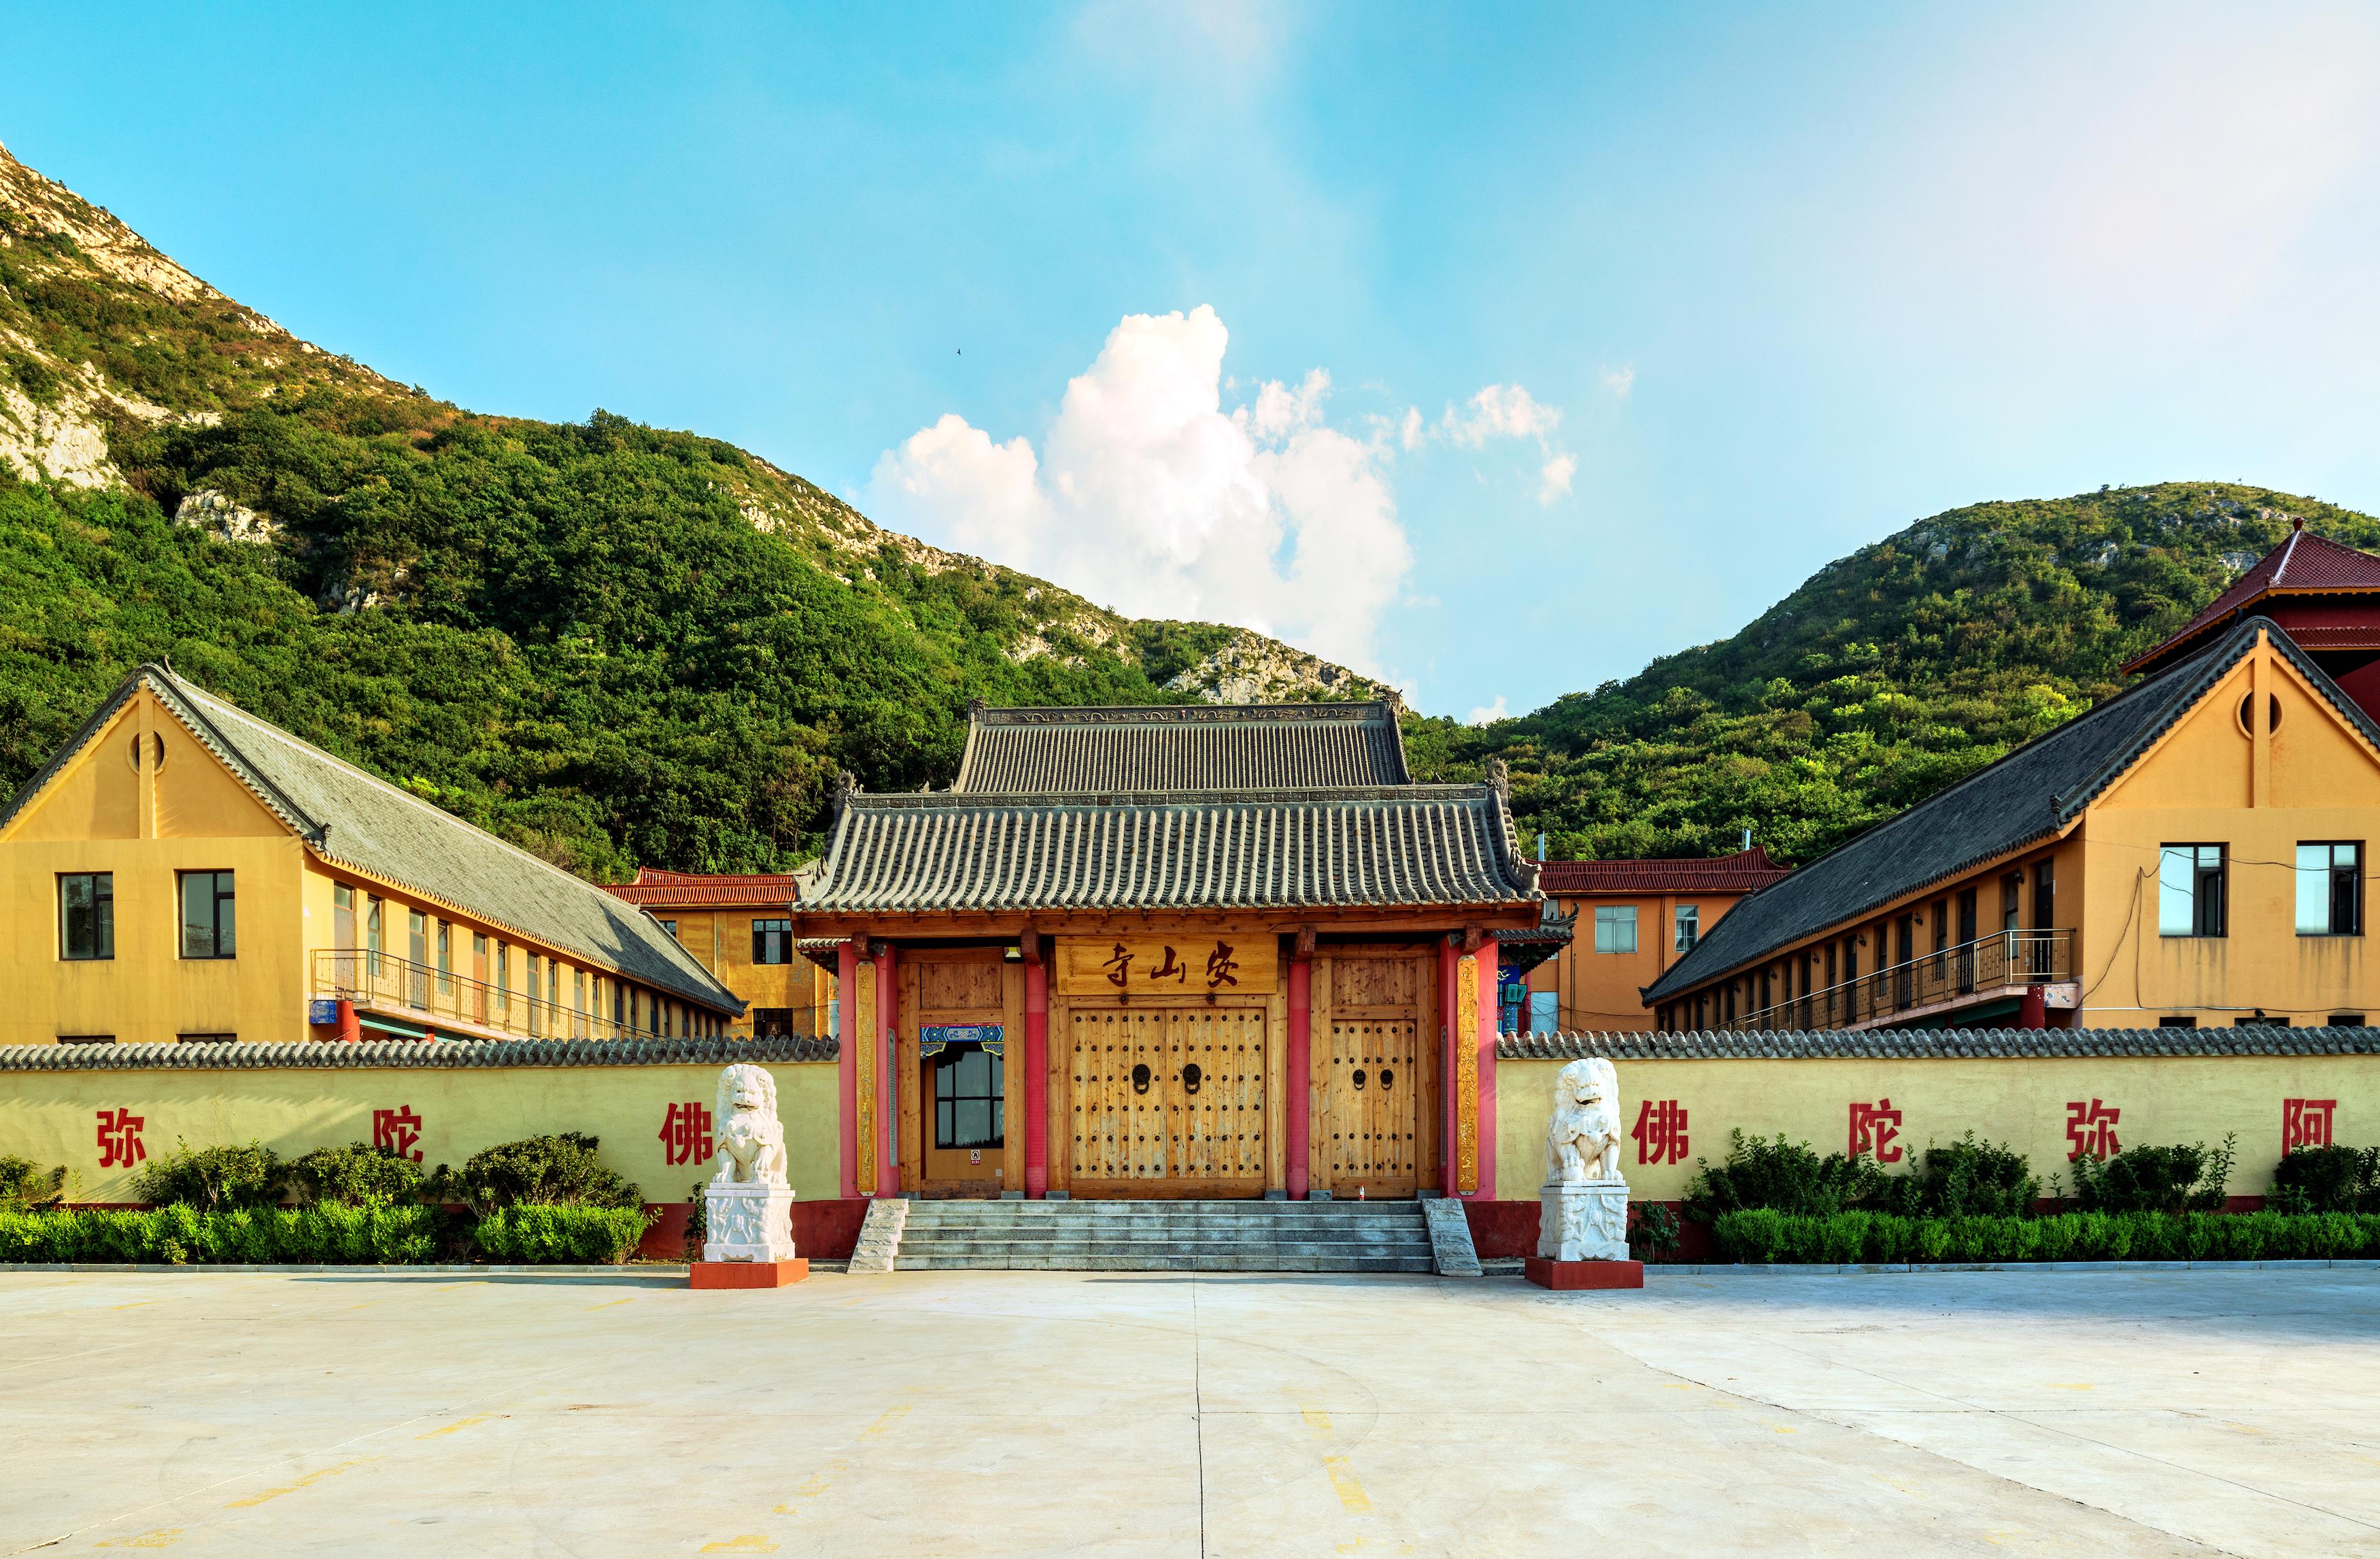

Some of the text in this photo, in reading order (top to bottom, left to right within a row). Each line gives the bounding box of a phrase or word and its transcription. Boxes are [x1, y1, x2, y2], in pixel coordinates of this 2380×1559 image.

[97, 1102, 713, 1167] 弥 陀 佛
[1631, 1098, 2337, 1165] 阿 弥 陀 佛
